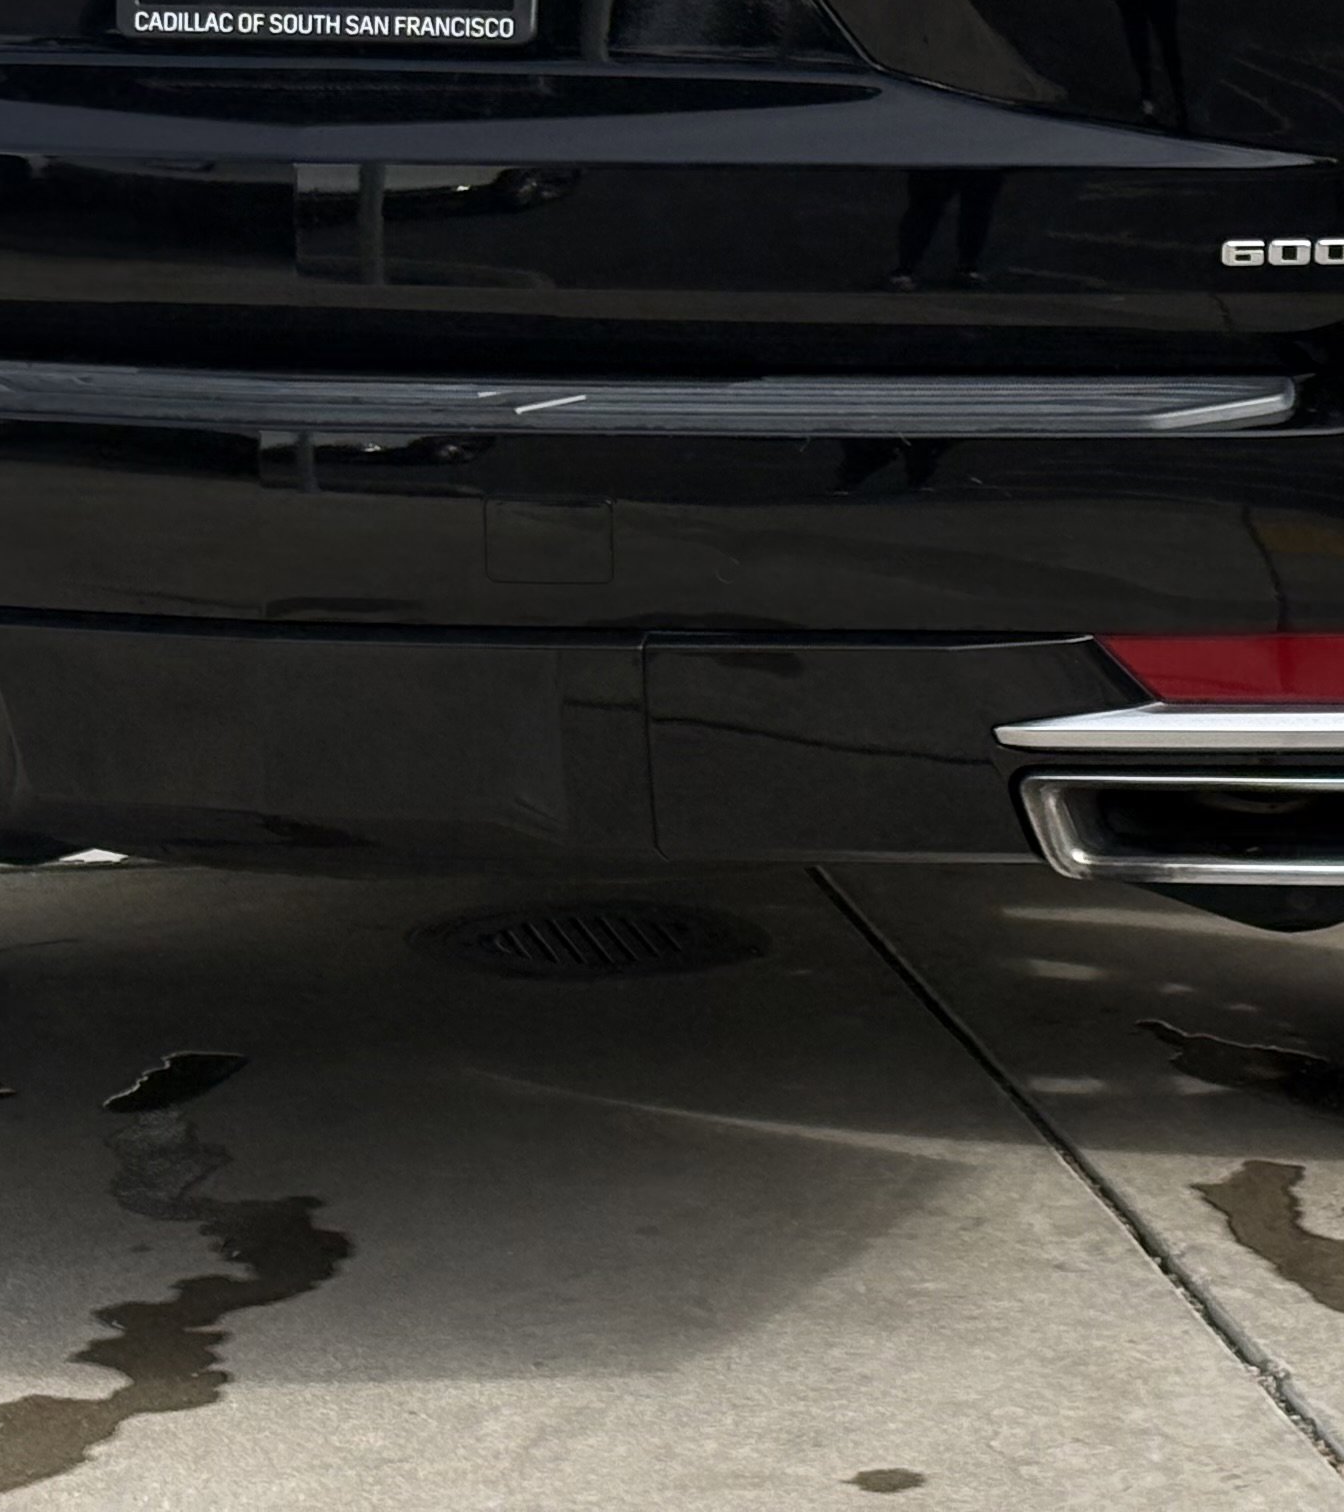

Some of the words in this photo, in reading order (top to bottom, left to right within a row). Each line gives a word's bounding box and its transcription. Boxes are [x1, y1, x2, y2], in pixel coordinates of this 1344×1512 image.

[133, 9, 235, 33] CADILLAC
[237, 12, 266, 34] OF
[268, 13, 341, 35] SOUTH
[344, 14, 390, 36] SAN
[394, 15, 515, 39] FRANCISCO
